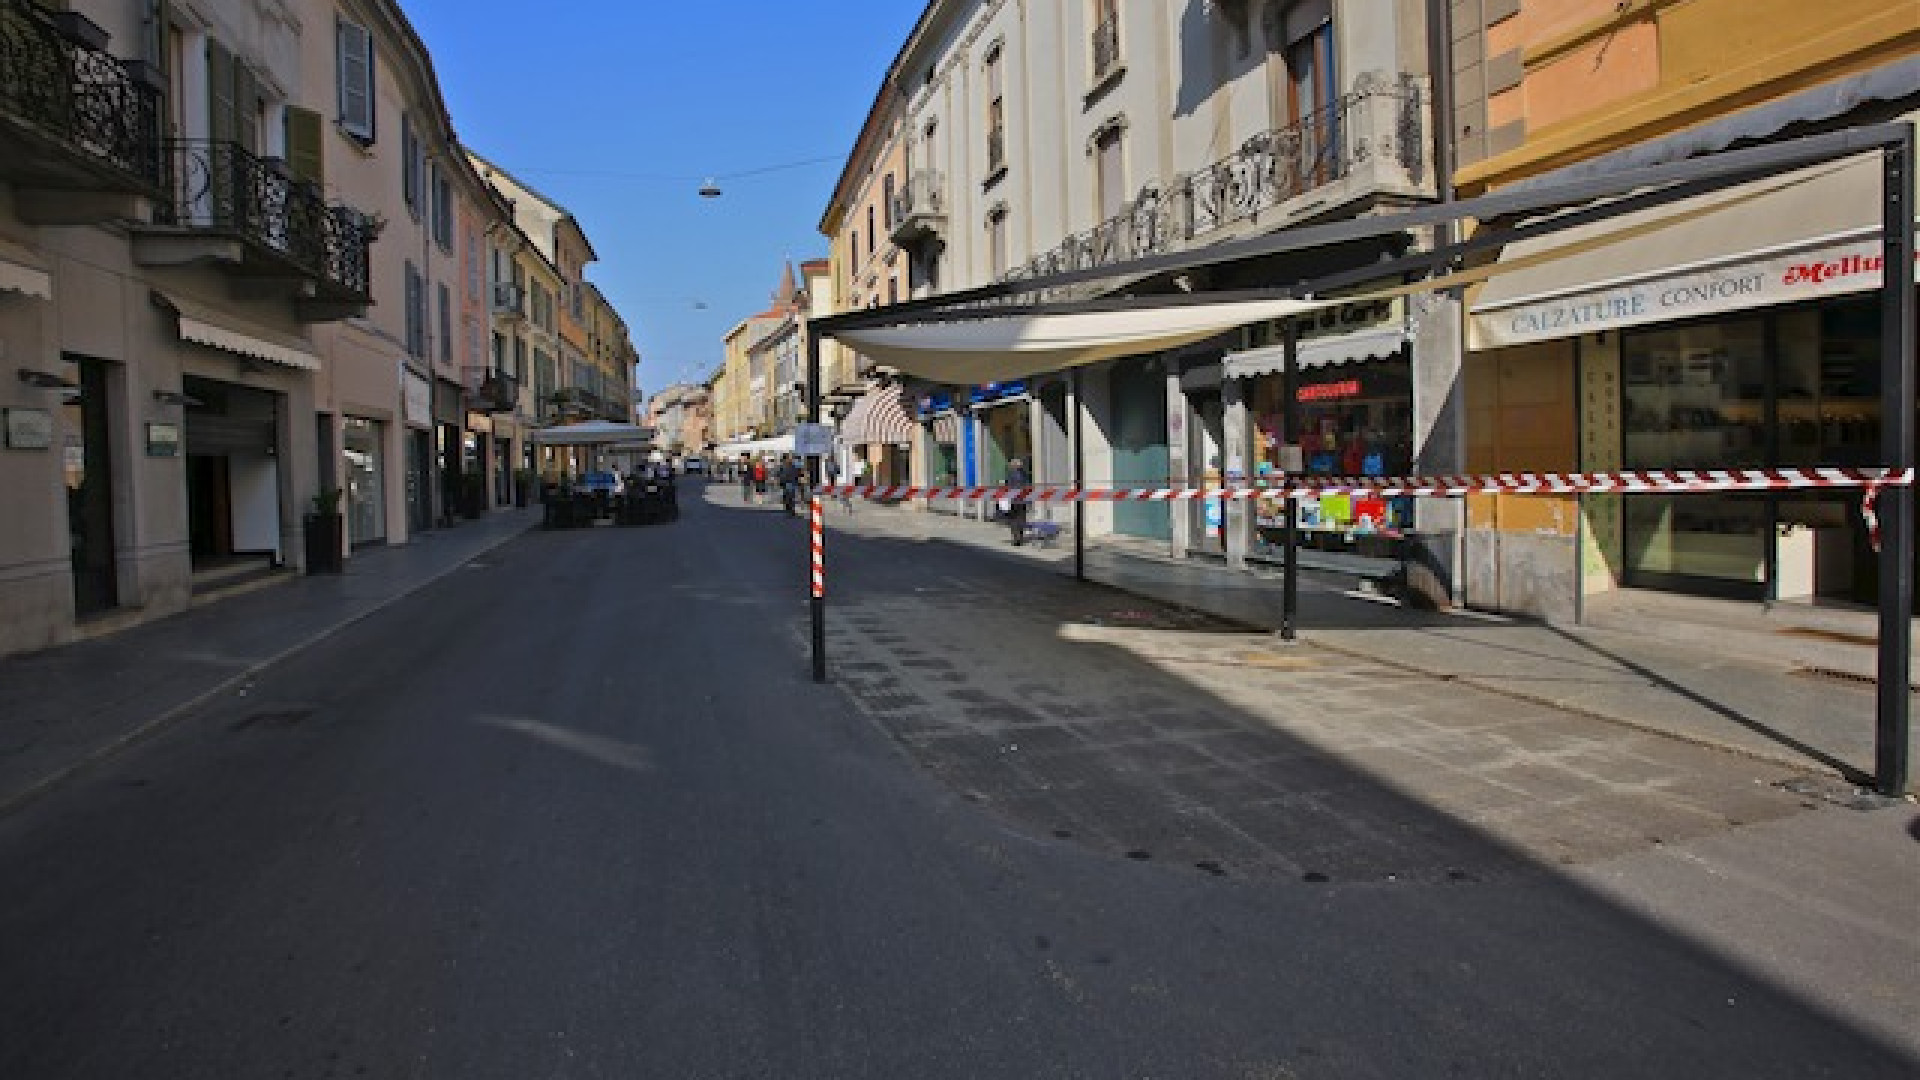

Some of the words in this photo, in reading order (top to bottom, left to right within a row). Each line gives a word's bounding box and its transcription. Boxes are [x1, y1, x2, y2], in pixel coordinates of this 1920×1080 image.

[1782, 254, 1884, 285] Mellu
[1511, 294, 1645, 334] CALZATURE
[1660, 273, 1765, 306] CONFORT
